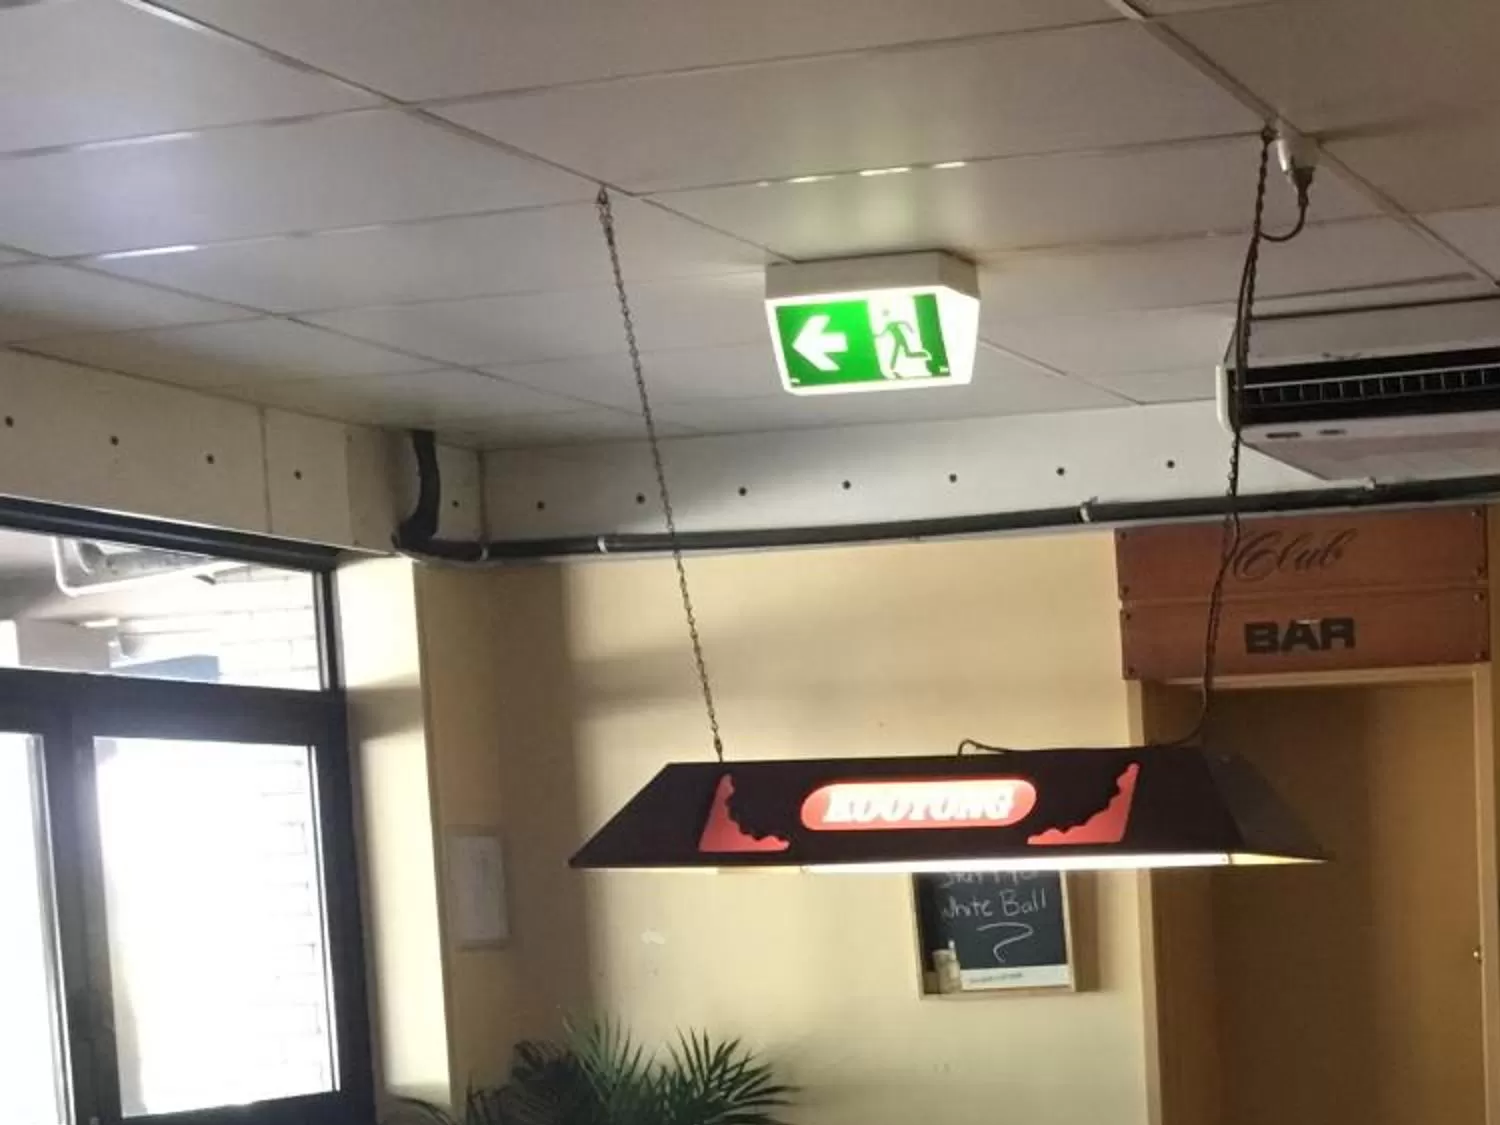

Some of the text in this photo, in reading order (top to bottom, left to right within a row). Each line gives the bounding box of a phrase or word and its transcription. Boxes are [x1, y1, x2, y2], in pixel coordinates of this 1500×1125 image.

[1231, 527, 1359, 583] Club
[1244, 617, 1357, 655] BAR
[1000, 887, 1047, 917] Ball
